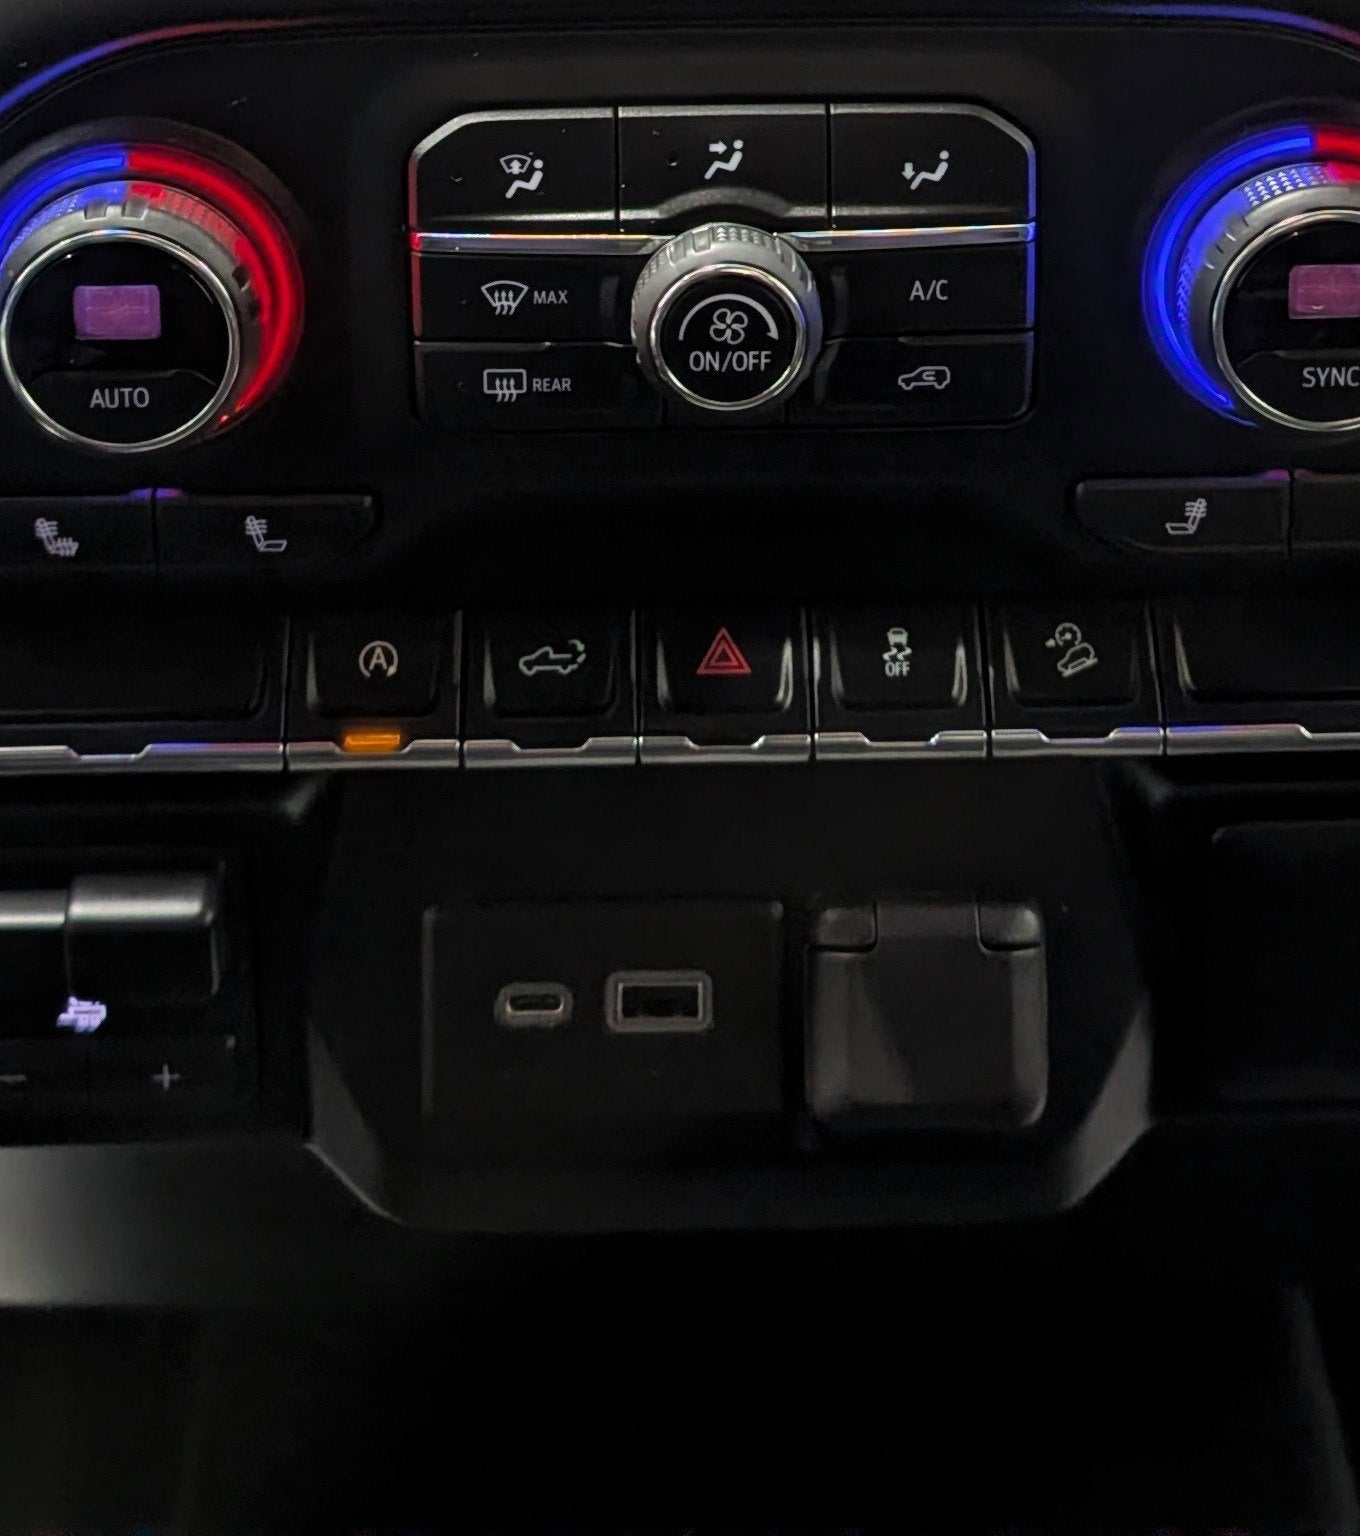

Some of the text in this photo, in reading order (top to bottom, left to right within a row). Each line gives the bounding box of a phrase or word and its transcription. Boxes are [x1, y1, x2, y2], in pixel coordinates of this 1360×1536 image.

[533, 289, 568, 305] MAX
[909, 279, 949, 301] A/C
[688, 350, 772, 373] ON/OFF
[532, 377, 572, 393] REAR
[1302, 365, 1360, 388] SYNC
[90, 386, 150, 409] AUTO
[883, 660, 911, 677] OFF
